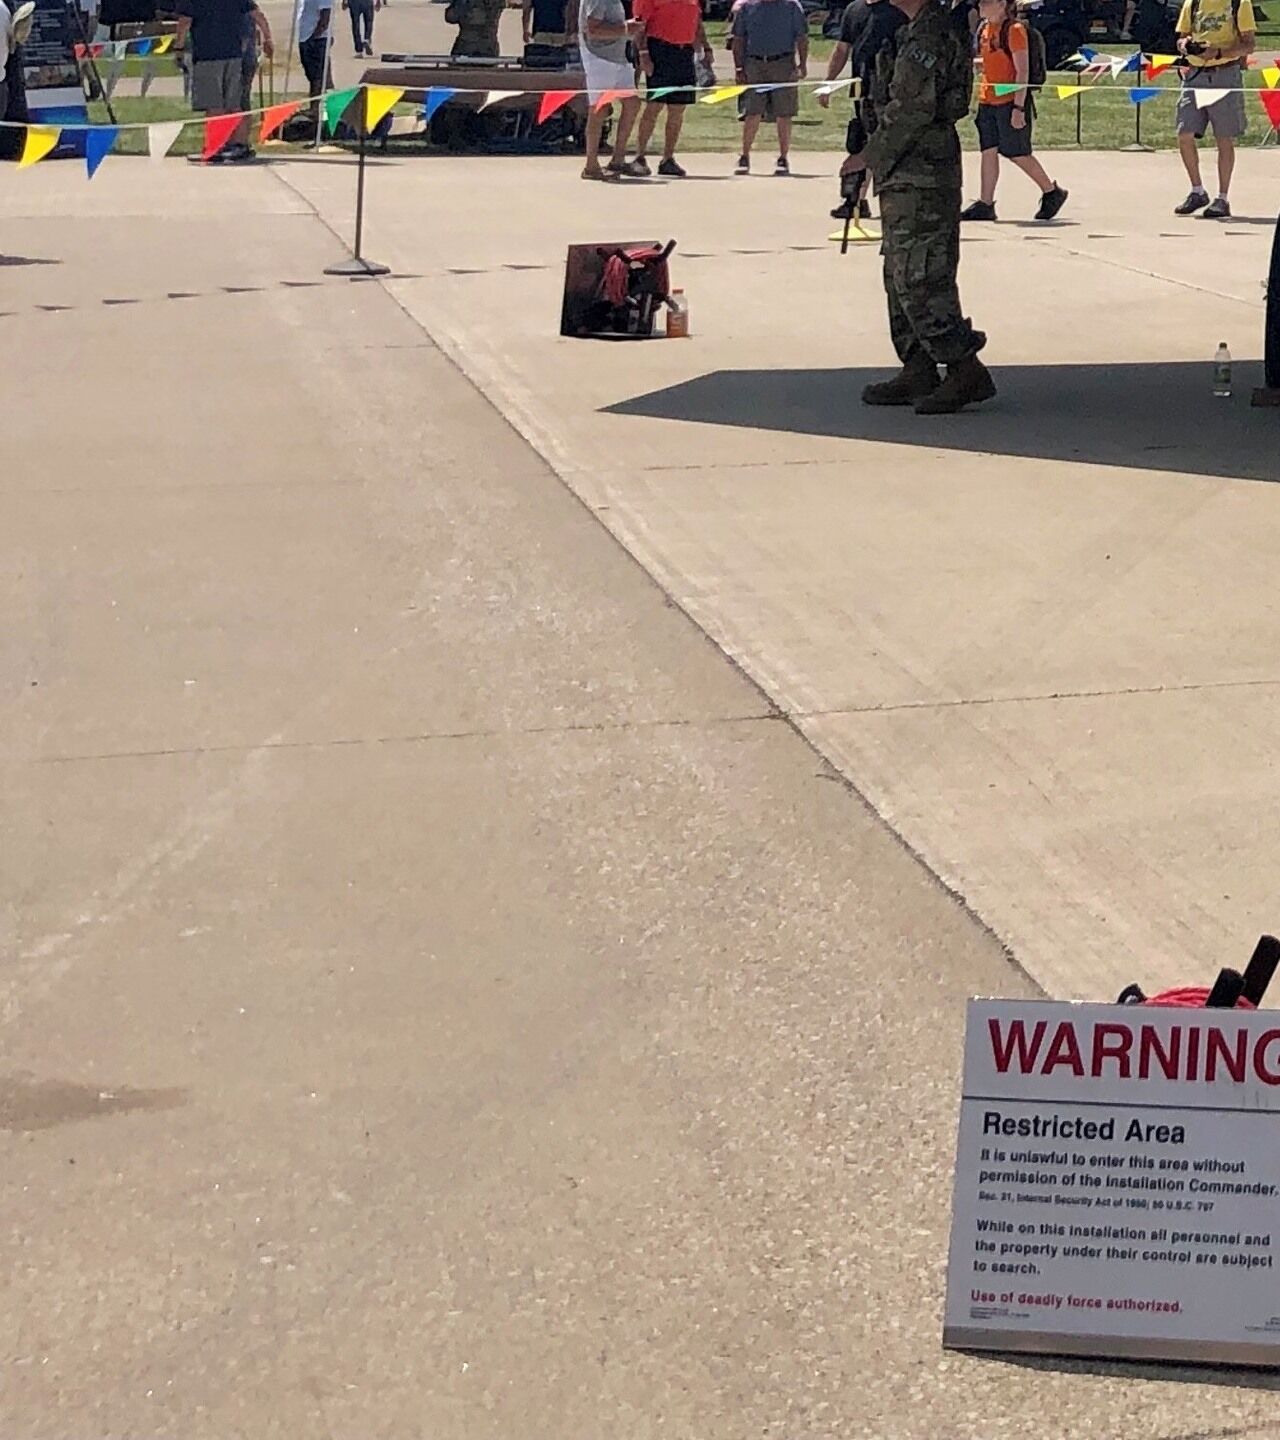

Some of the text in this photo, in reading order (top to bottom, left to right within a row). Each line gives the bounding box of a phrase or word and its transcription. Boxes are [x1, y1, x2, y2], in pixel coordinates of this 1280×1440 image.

[982, 1111, 1186, 1144] Restricted Area
[981, 1148, 1245, 1173] It is unlawful to enter this area without
[978, 1169, 1057, 1185] permission
[1061, 1172, 1076, 1186] of
[1080, 1173, 1101, 1187] the
[1055, 1194, 1092, 1207] Security
[1095, 1197, 1111, 1207] Act
[1113, 1197, 1123, 1208] of
[977, 1219, 1014, 1233] While
[1018, 1223, 1035, 1234] on
[1040, 1222, 1065, 1236] this
[1150, 1228, 1167, 1241] all
[1171, 1231, 1240, 1244] personnel
[1245, 1234, 1271, 1246] and
[975, 1240, 1273, 1269] the property under their control are subject
[973, 1260, 1041, 1275] to search.
[971, 1289, 996, 1302] Use
[1000, 1291, 1015, 1303] of
[1018, 1293, 1063, 1309] deadly
[1067, 1295, 1102, 1308] force
